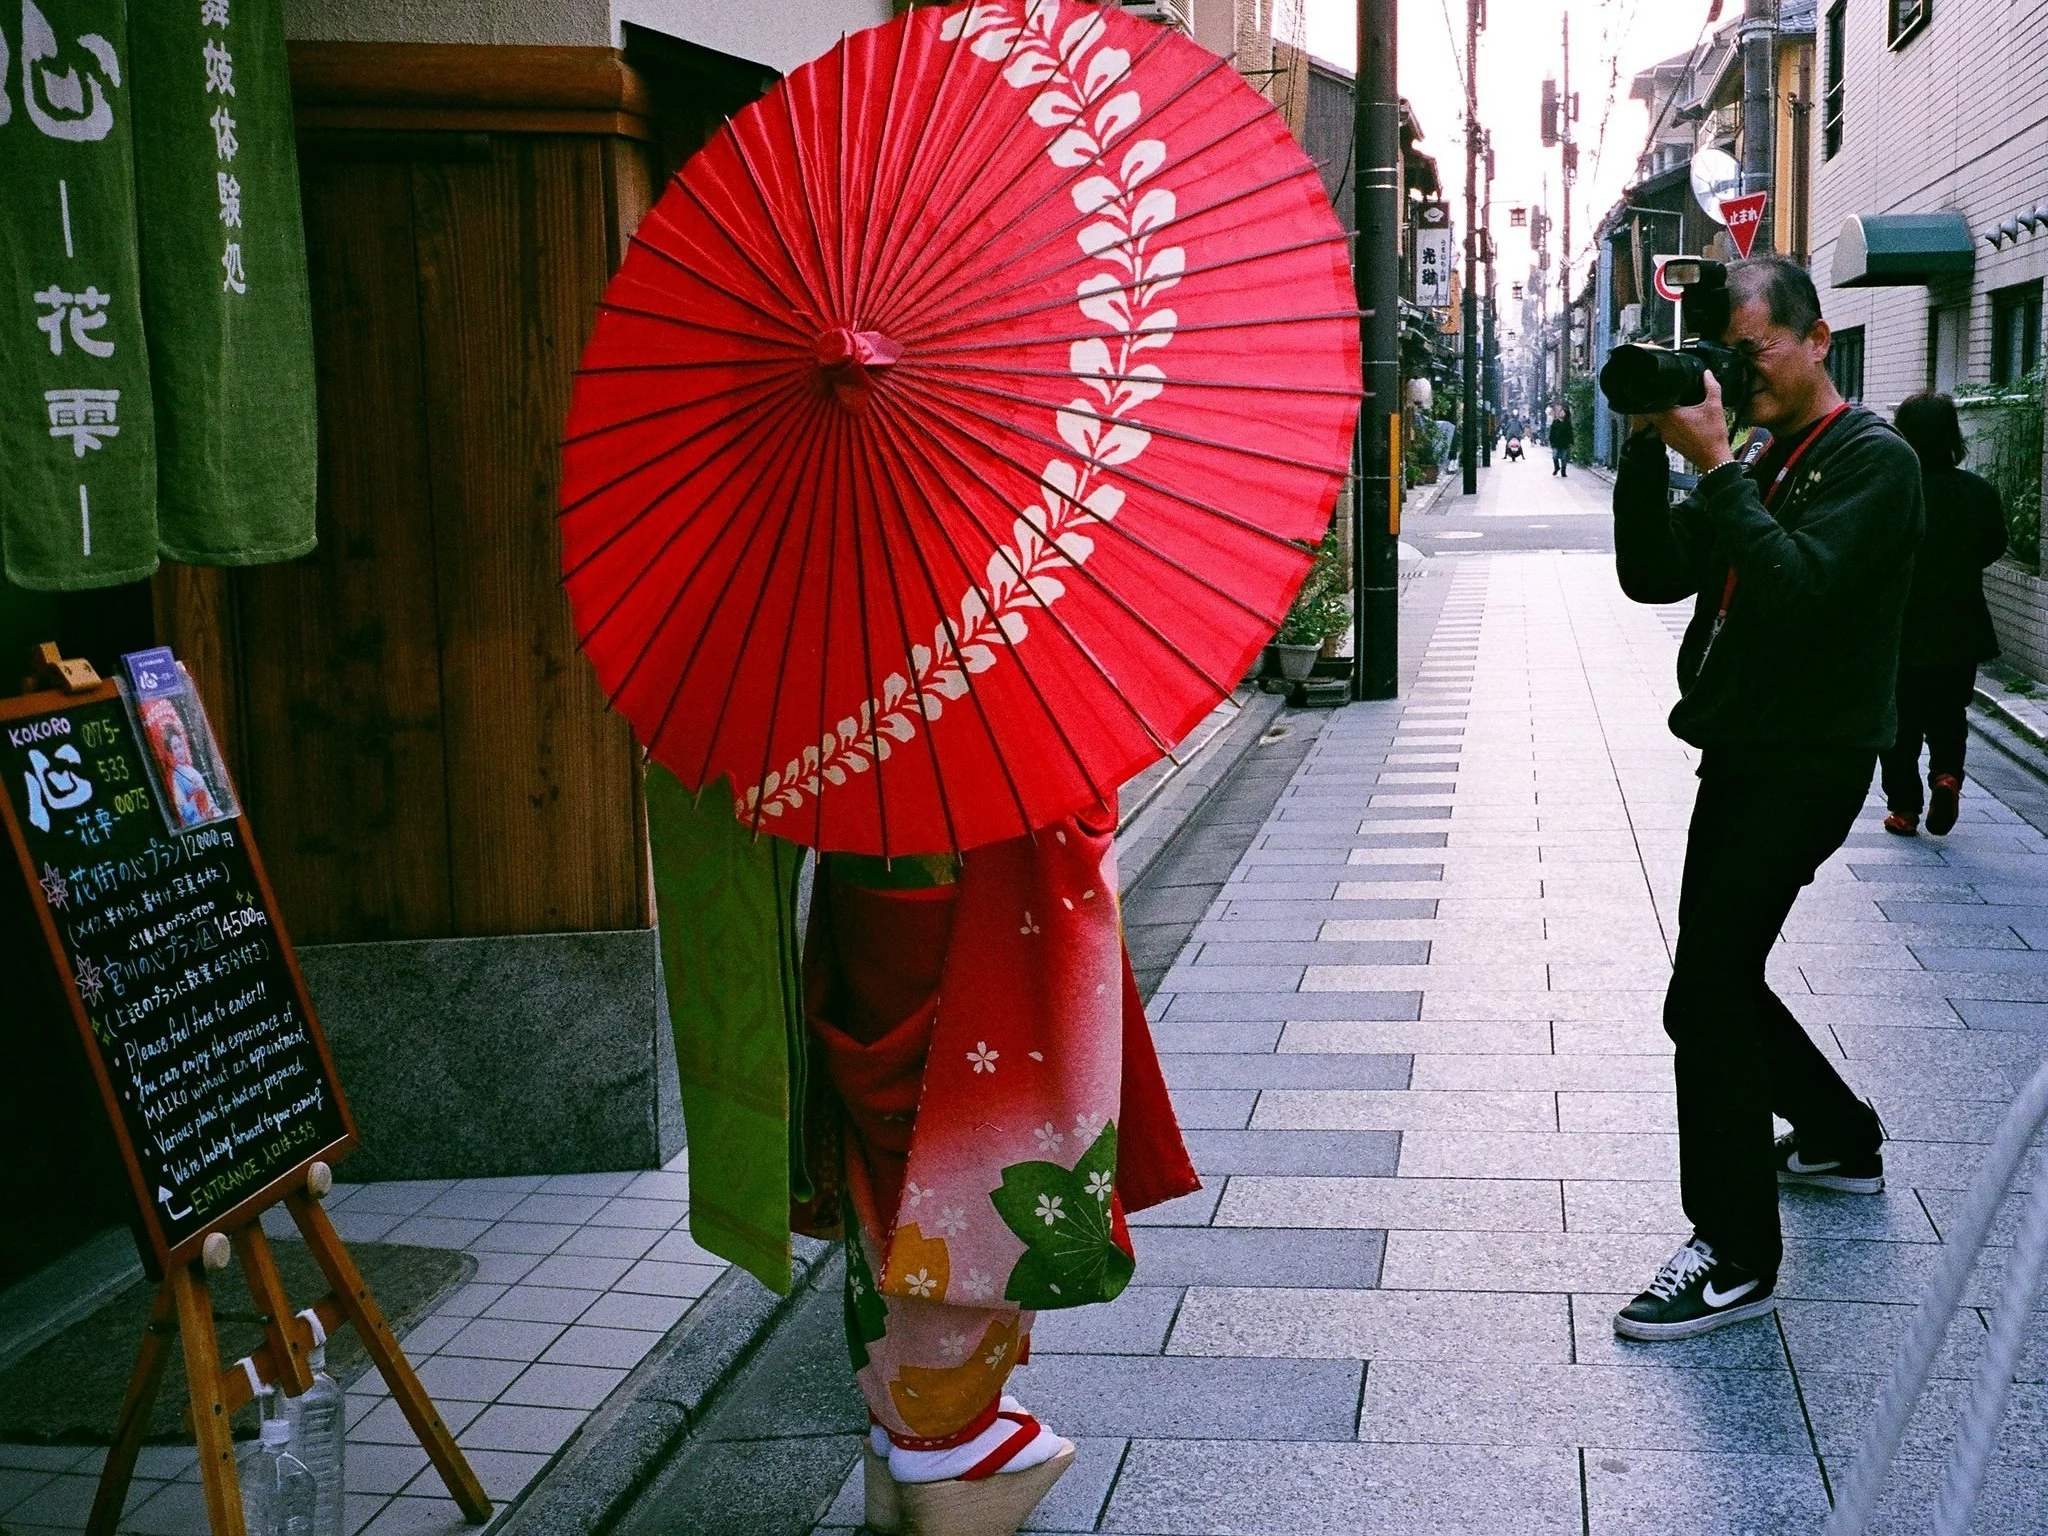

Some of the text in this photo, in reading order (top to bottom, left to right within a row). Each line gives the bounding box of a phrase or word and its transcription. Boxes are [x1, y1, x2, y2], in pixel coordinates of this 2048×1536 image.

[1729, 207, 1758, 225] 止まれ
[8, 717, 71, 748] KOKORO
[24, 744, 92, 833] 心
[96, 755, 129, 782] 533
[115, 788, 149, 814] 0075
[125, 981, 266, 1073] Please feel free to enter!!
[133, 1001, 293, 1102] You can enjoy the experience of
[191, 1069, 229, 1102] without
[233, 1060, 249, 1075] an
[153, 1120, 193, 1154] Various
[195, 1106, 217, 1138] plans
[219, 1095, 232, 1117] for
[232, 1090, 249, 1112] that
[250, 1083, 262, 1098] are
[200, 1134, 233, 1168] looking
[231, 1112, 264, 1146] forward
[264, 1108, 274, 1130] to
[273, 1106, 291, 1131] your
